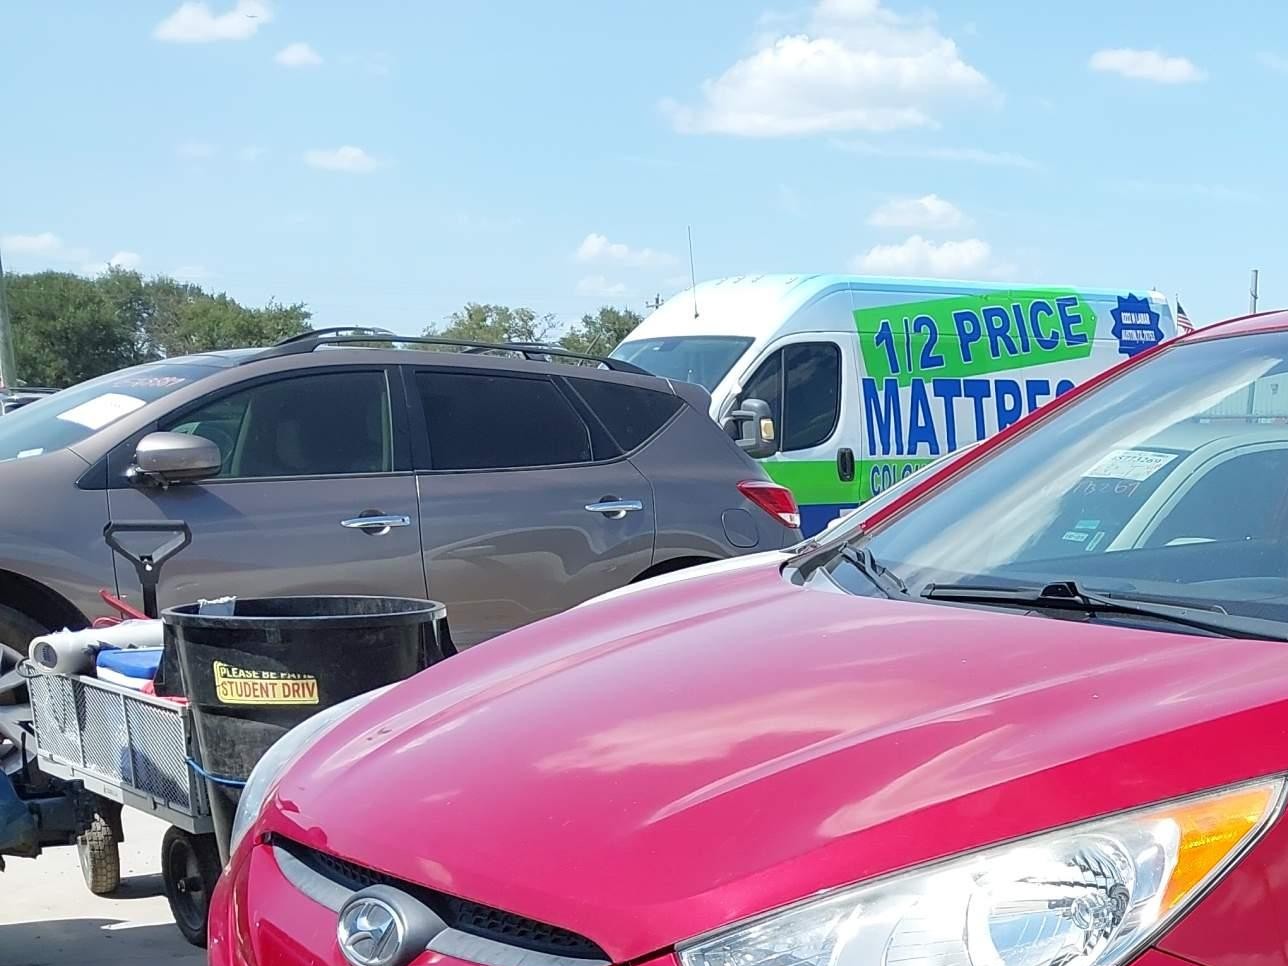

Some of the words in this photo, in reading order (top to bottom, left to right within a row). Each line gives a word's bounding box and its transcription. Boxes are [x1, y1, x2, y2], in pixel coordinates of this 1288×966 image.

[874, 315, 945, 374] 1/2
[953, 296, 1089, 363] PRICE
[862, 377, 1076, 456] MATTR
[220, 667, 260, 679] PLEASE
[221, 681, 278, 699] STUDENT
[281, 682, 315, 699] DRIV
